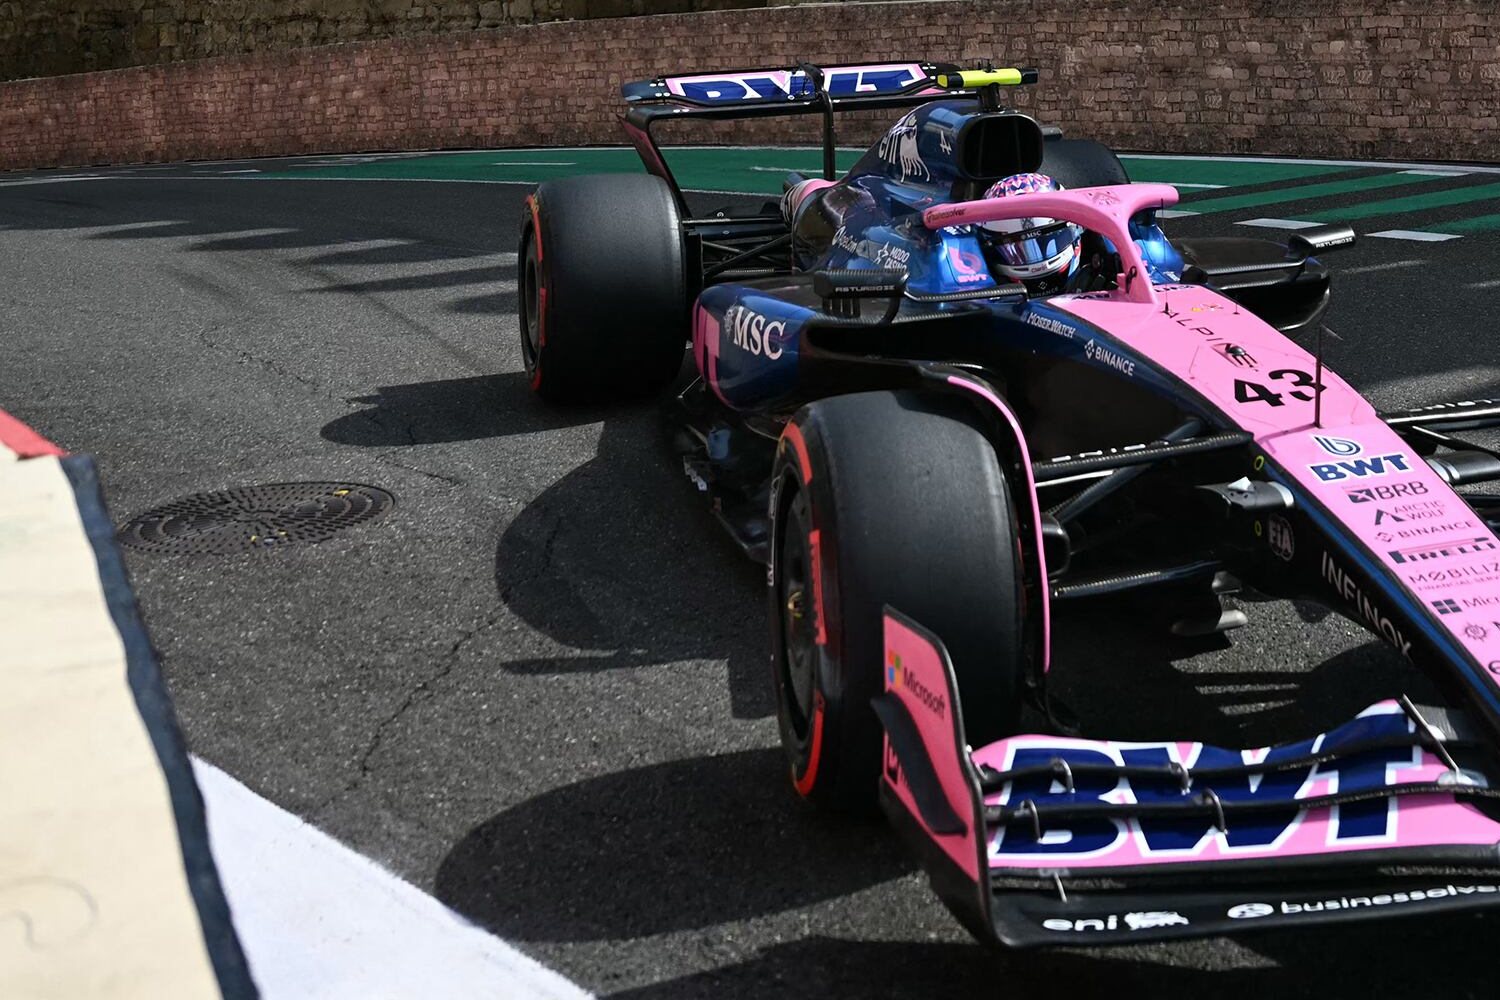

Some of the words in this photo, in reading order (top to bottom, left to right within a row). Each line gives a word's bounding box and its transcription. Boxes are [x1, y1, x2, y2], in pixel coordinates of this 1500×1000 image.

[889, 246, 910, 263] MODO
[734, 306, 786, 360] MSC
[1095, 347, 1136, 377] BINANCE
[1234, 369, 1328, 408] 43
[1309, 454, 1410, 482] BWT
[1374, 480, 1430, 500] BRB
[1394, 500, 1447, 514] ARCTIC
[1404, 509, 1445, 521] WOLF
[1399, 519, 1478, 539] BINANCE
[1387, 537, 1497, 564] PIRELLI
[1321, 550, 1414, 665] INFINOX
[903, 667, 945, 721] Microsoft
[994, 704, 1420, 858] BWT
[1043, 914, 1118, 932] eni
